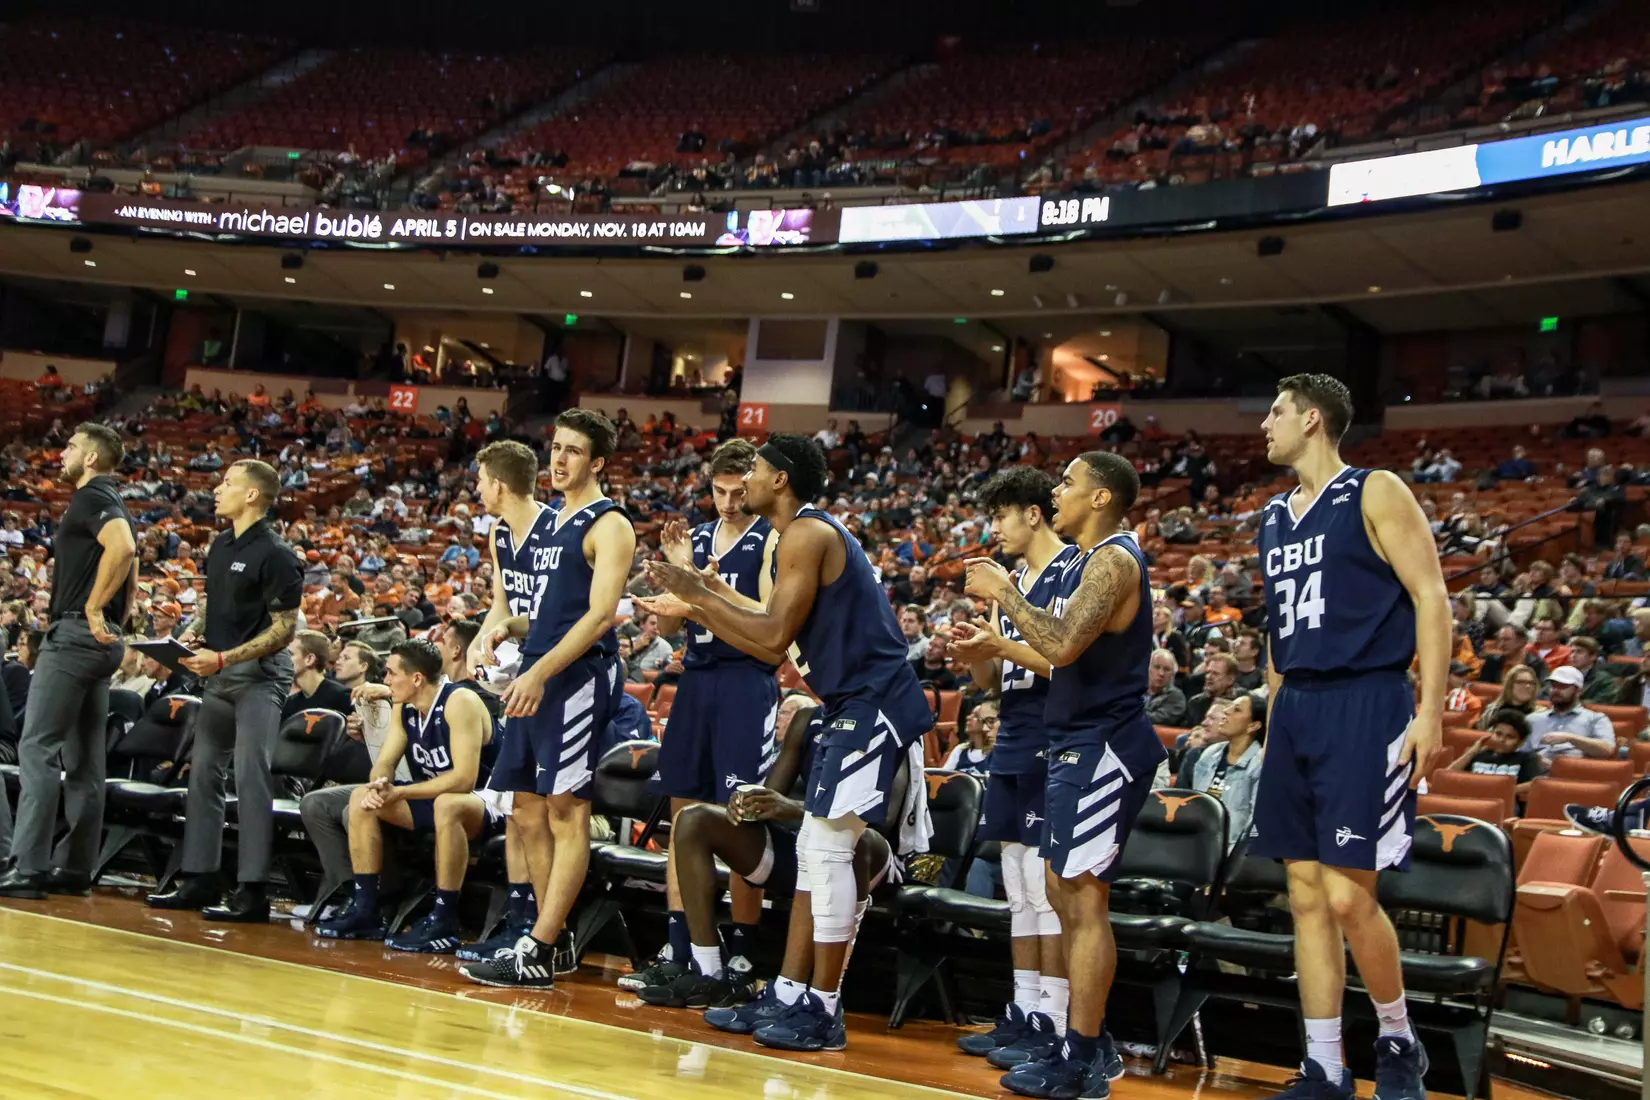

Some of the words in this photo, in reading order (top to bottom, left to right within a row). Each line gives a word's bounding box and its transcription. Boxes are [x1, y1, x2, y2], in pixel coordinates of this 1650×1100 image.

[1542, 125, 1650, 168] HARLE
[120, 205, 137, 218] AN
[138, 206, 183, 222] EVENING
[184, 210, 212, 224] WITH
[219, 209, 310, 235] michael
[315, 212, 382, 238] bublé
[390, 218, 442, 237] APRIL
[445, 219, 457, 238] 5
[469, 222, 492, 237] ON
[494, 222, 526, 237] SALE
[527, 222, 590, 239] MONDAY,
[593, 222, 627, 238] NOV.
[632, 223, 647, 238] 18
[647, 222, 667, 237] AT
[669, 222, 706, 237] 10AM
[1041, 199, 1079, 225] 8:18
[1081, 196, 1110, 223] PM
[392, 391, 414, 408] 22
[742, 407, 764, 425] 21
[1091, 409, 1117, 428] 20
[1332, 492, 1351, 505] WAC
[533, 546, 563, 571] CBU
[1266, 534, 1325, 577] CBU
[501, 568, 535, 595] CBU
[1274, 570, 1325, 639] 34
[412, 743, 450, 769] CBU
